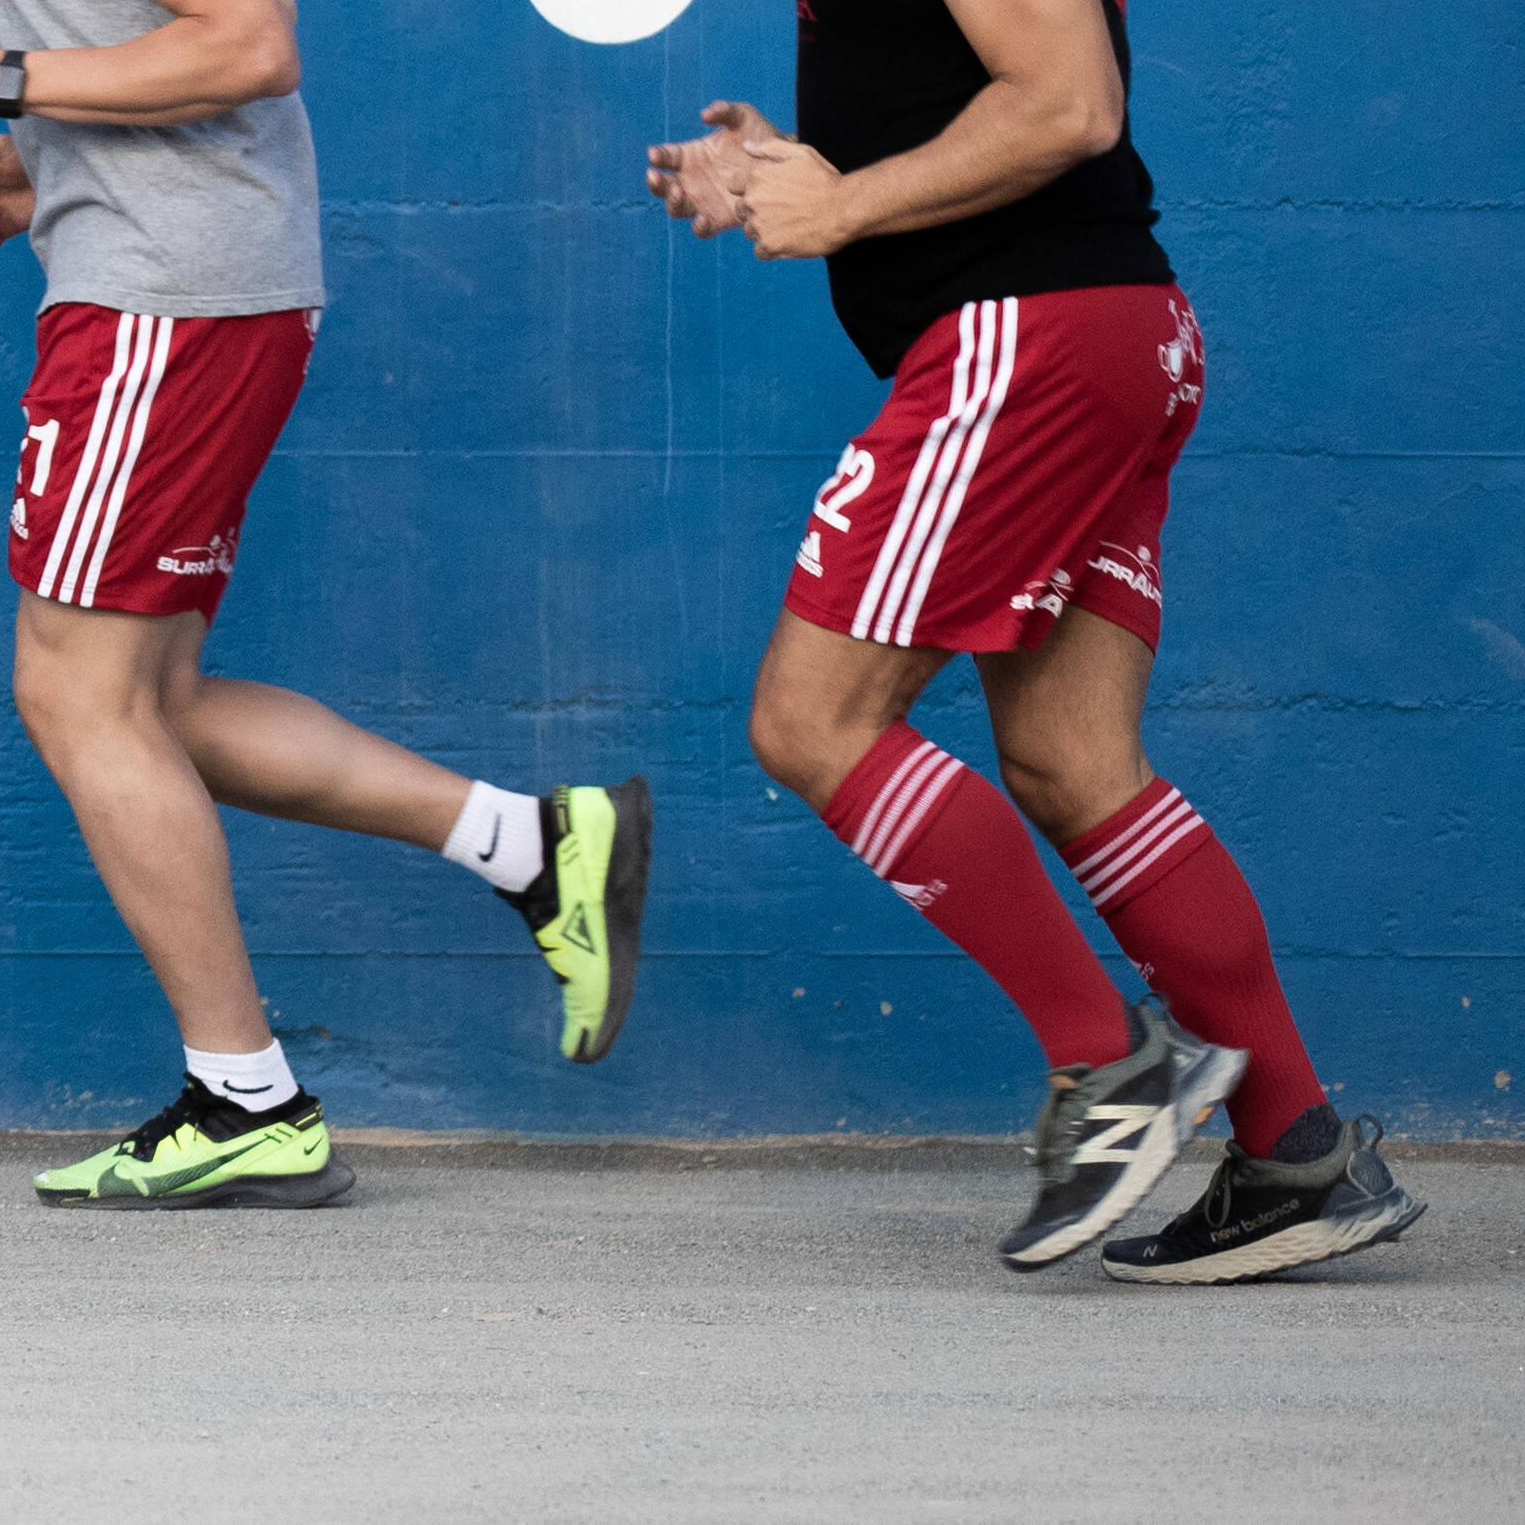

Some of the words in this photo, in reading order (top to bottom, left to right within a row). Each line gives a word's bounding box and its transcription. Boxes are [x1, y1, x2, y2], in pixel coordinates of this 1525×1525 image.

[17, 405, 60, 497] 1
[1210, 1225, 1240, 1243] new
[1240, 1198, 1300, 1232] balance
